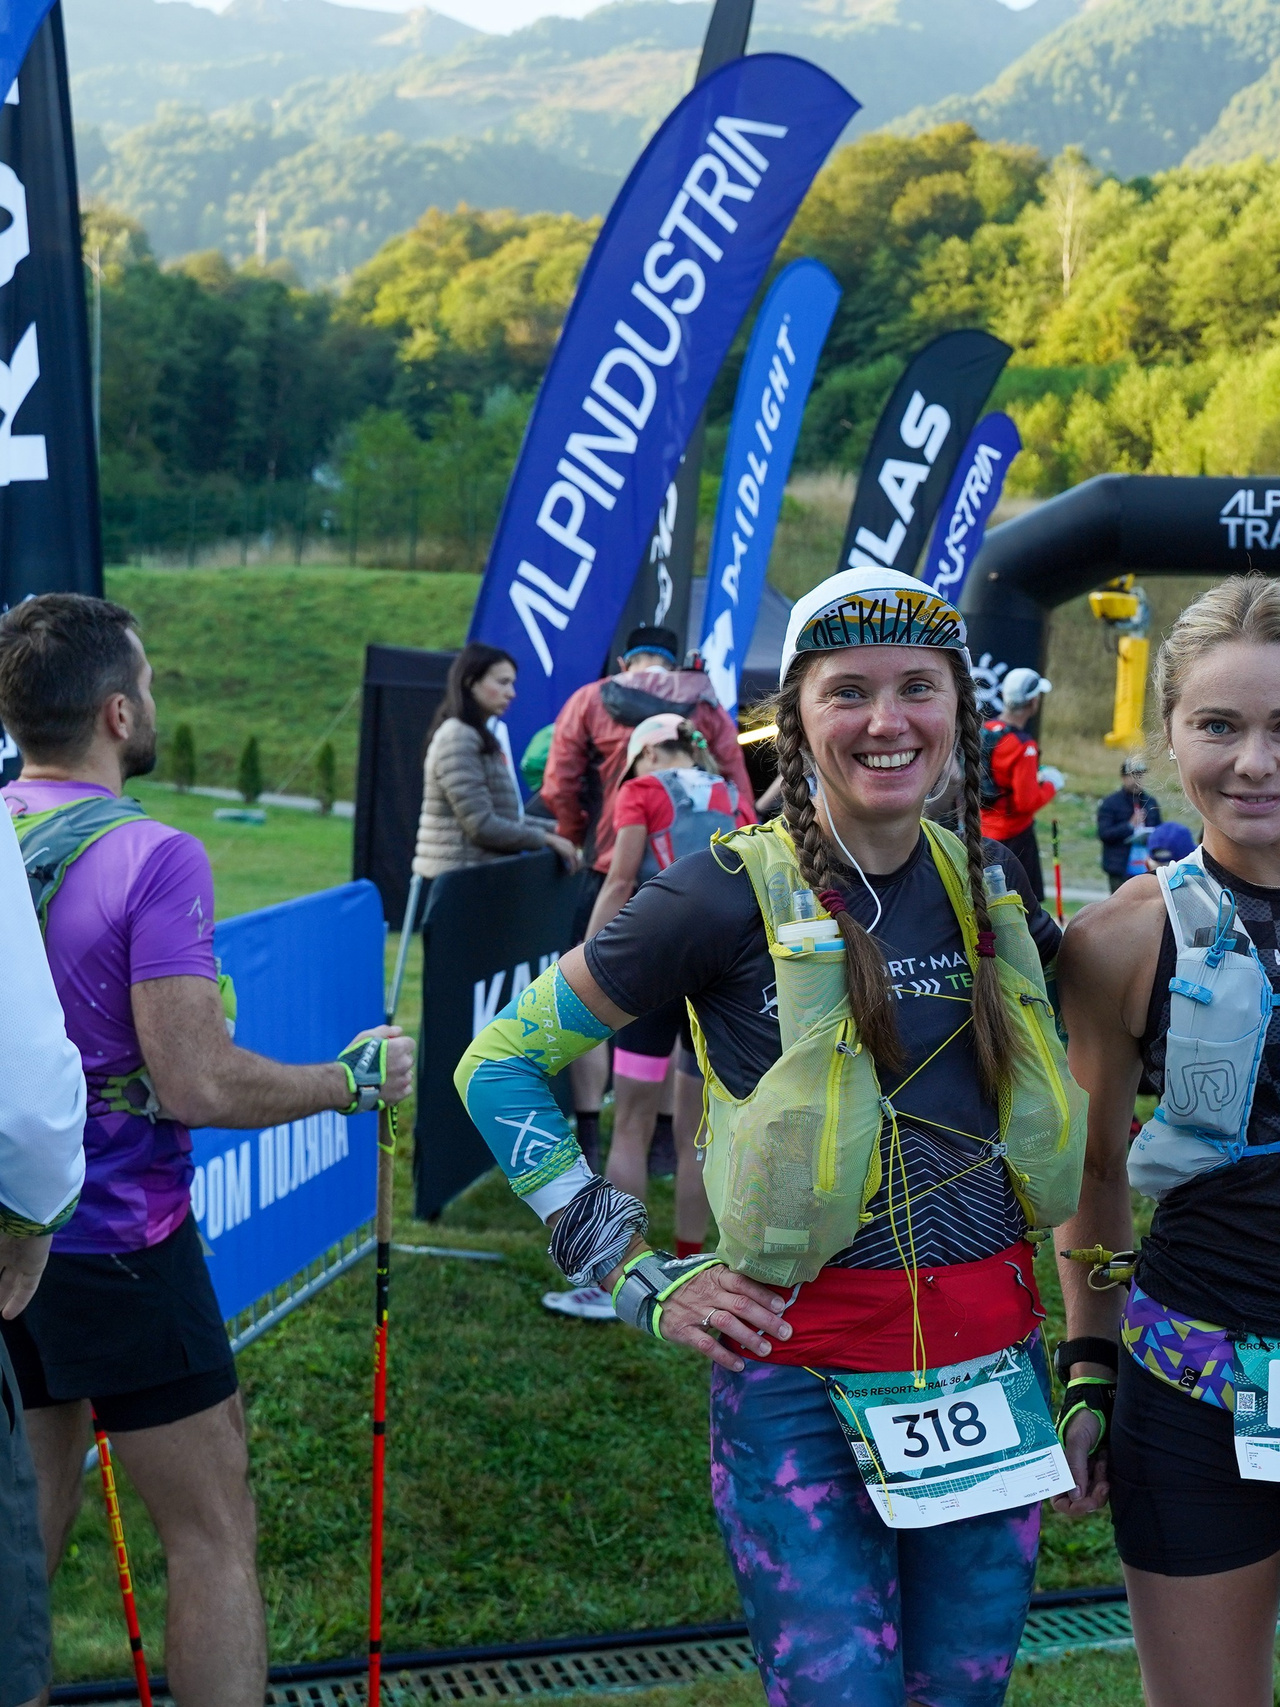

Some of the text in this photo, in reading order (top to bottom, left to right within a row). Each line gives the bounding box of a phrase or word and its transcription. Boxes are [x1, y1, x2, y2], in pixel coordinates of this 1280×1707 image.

[509, 116, 788, 677] ALPINDUSTRIA
[812, 598, 925, 647] ЛЁГКИХ
[541, 1005, 562, 1064] TRAIL
[1019, 1129, 1052, 1145] ENERGY
[870, 1383, 919, 1396] RESORTS
[949, 1375, 961, 1385] 36
[892, 1401, 987, 1458] 318
